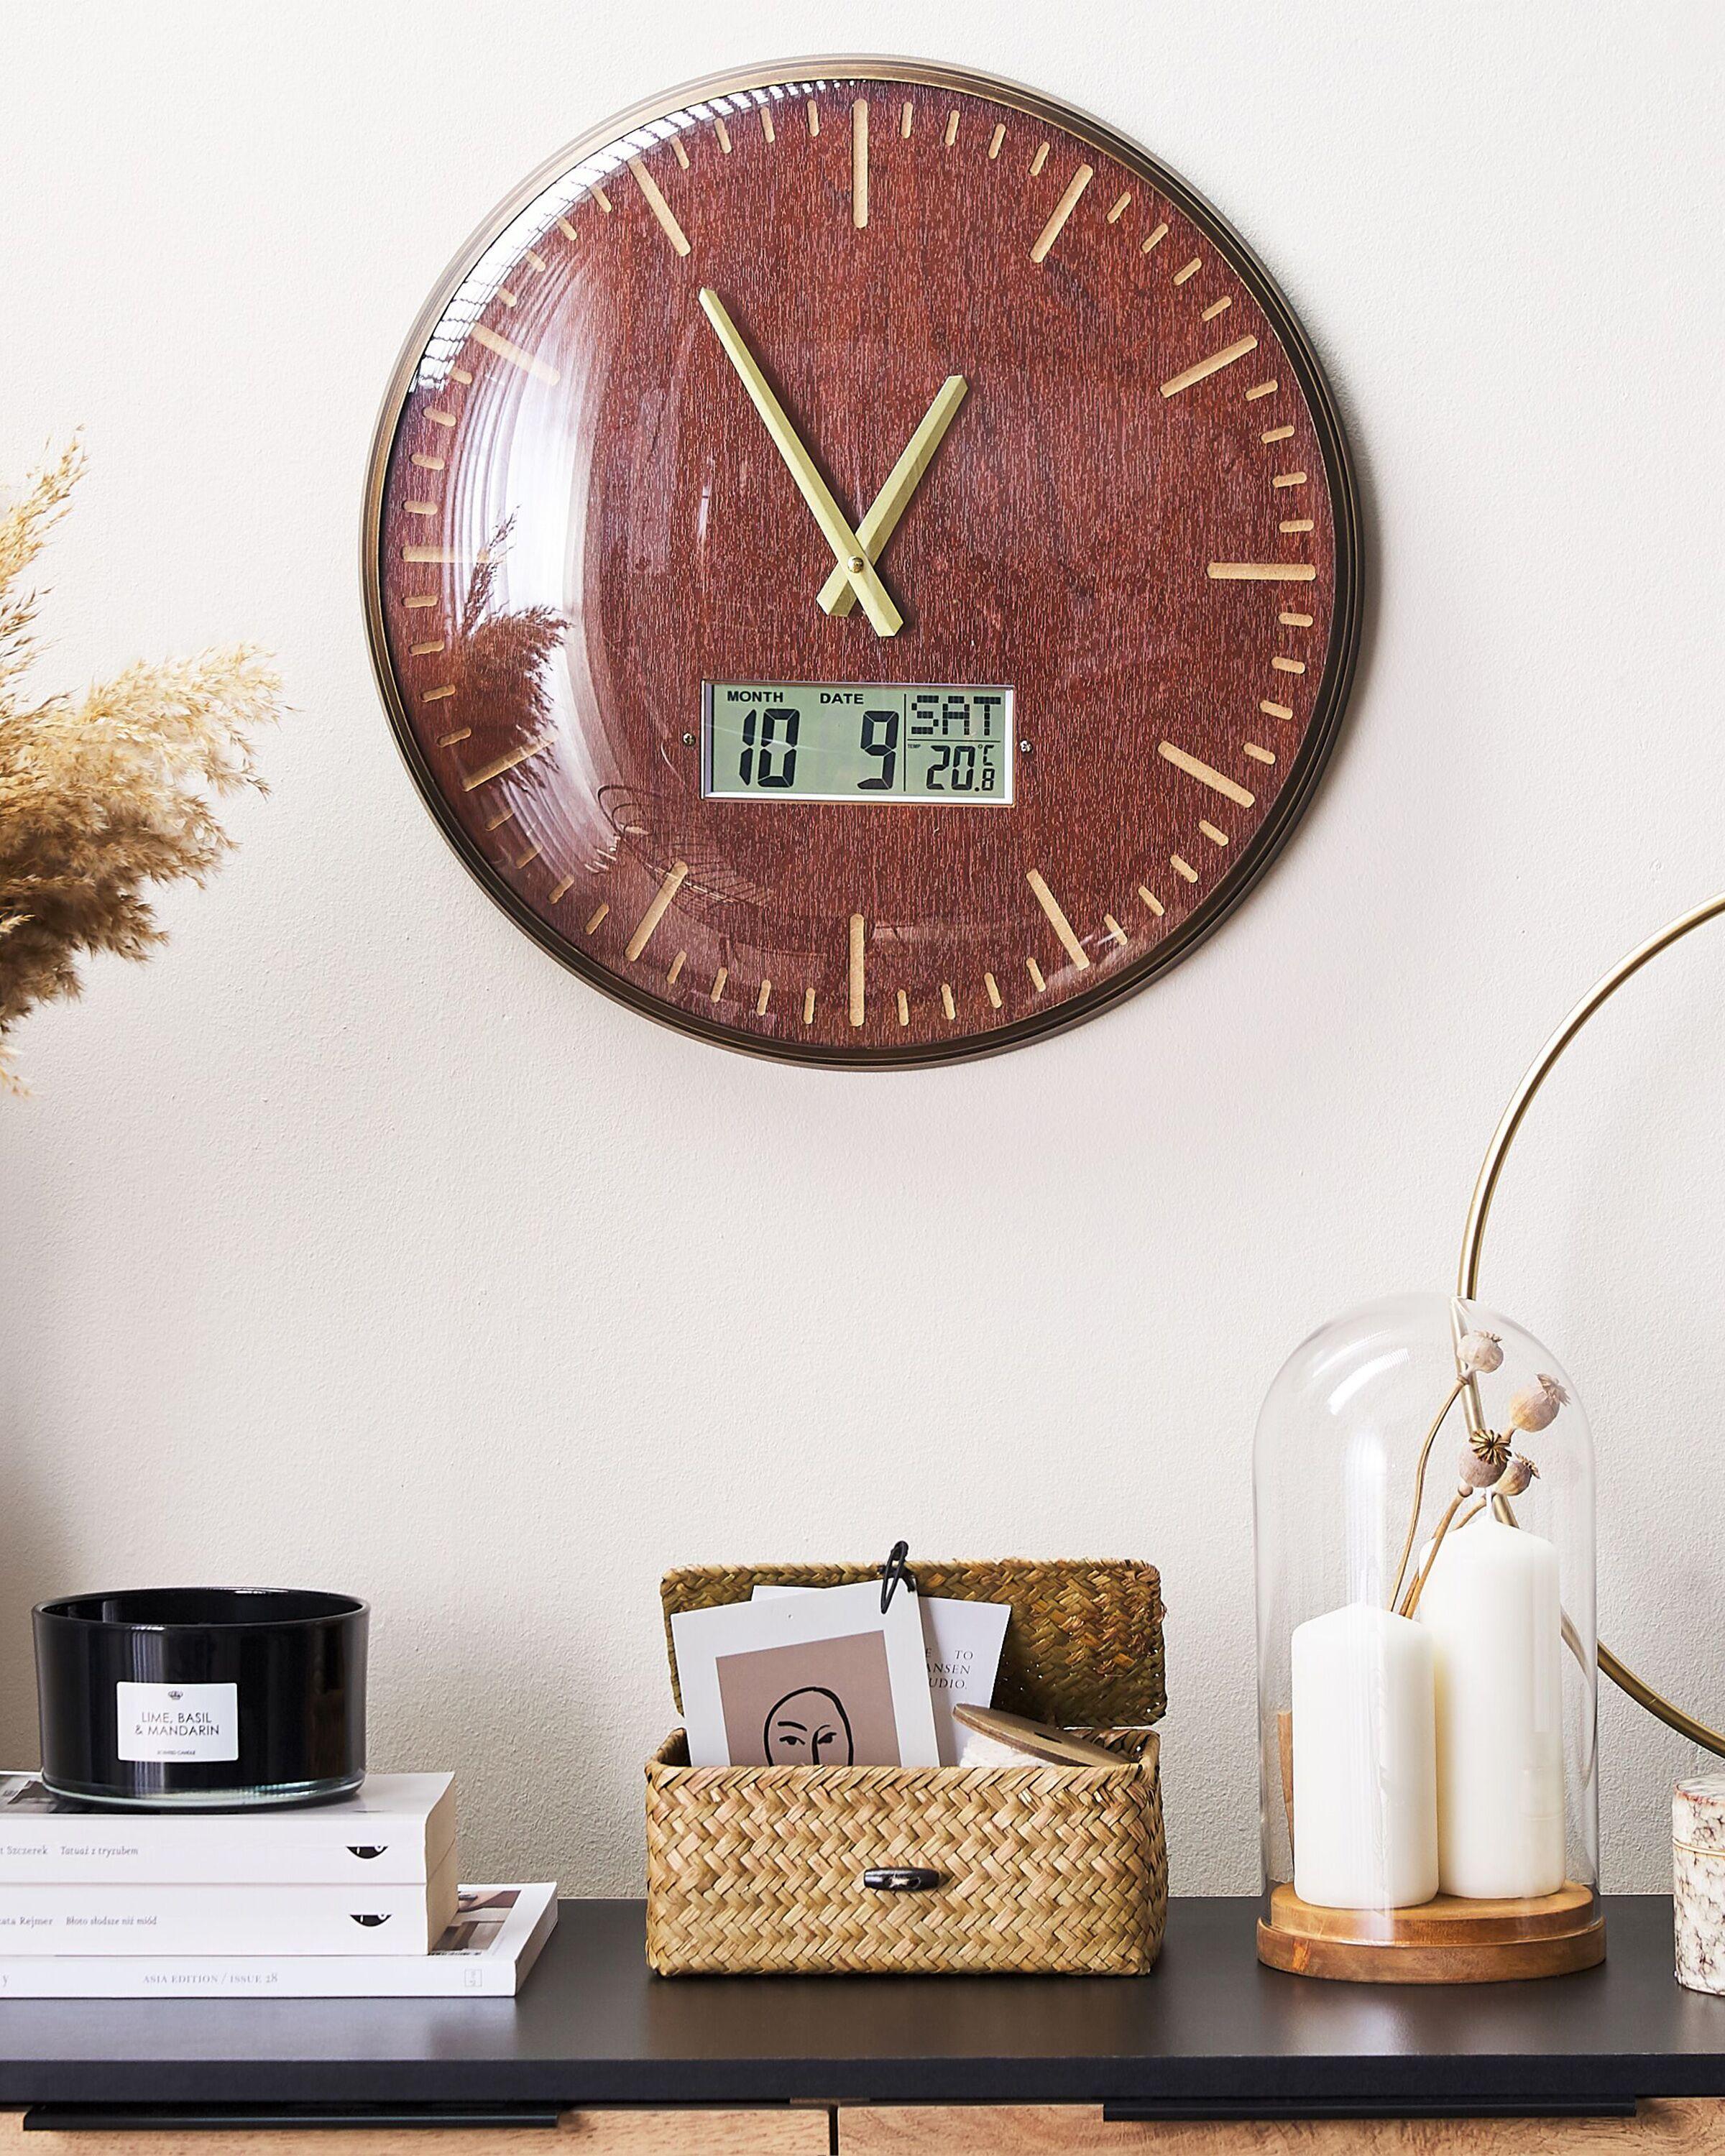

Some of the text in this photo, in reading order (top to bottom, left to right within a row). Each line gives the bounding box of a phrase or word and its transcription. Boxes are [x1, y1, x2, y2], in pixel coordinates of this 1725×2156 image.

[727, 691, 864, 705] MONTH DATE
[911, 695, 1001, 735] SAT
[739, 708, 899, 790] 10 9
[954, 1649, 973, 1660] TO
[142, 1712, 212, 1724] LIME, BASIL
[135, 1724, 219, 1736] & MANDARIN
[7, 1846, 48, 1856] Szczerek
[19, 1916, 52, 1929] Rejmer
[143, 1975, 167, 1984] ASIA
[172, 1975, 217, 1984] EDITION
[230, 1975, 262, 1984] ISSUE
